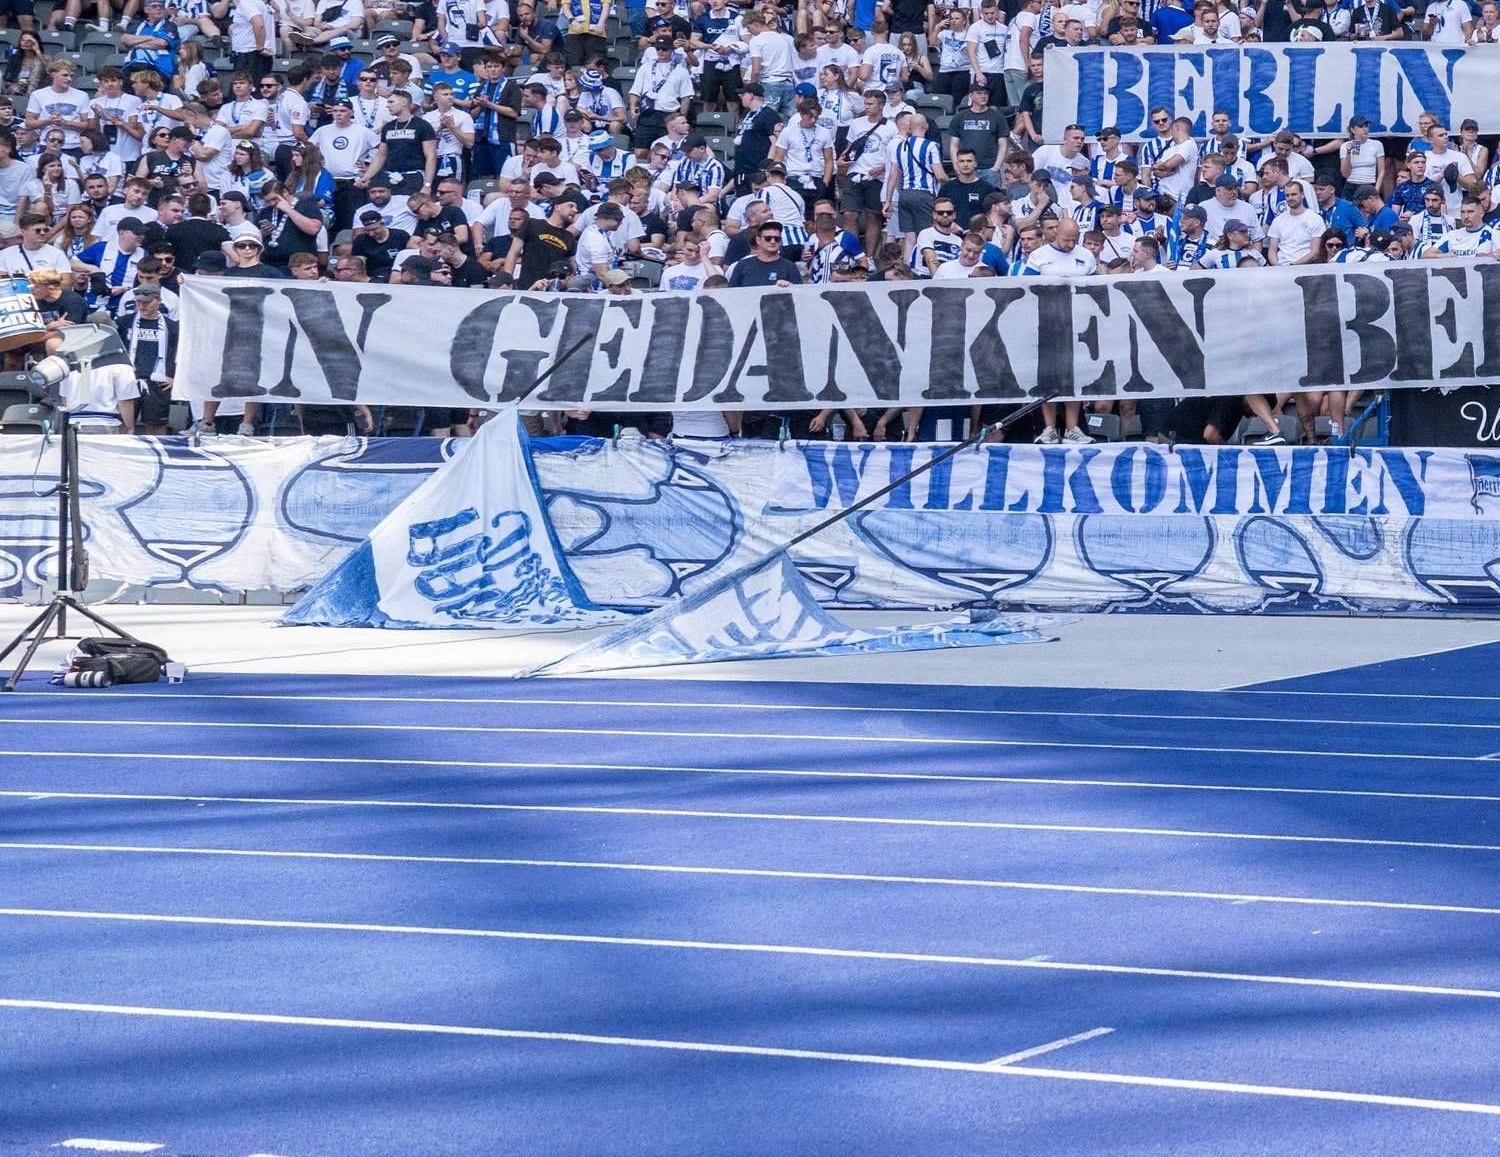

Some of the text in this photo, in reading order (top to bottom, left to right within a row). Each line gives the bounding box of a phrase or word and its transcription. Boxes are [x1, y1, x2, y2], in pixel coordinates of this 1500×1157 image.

[1072, 45, 1463, 141] BERLIN
[209, 285, 391, 401] IN
[450, 275, 1216, 404] GEDANKEN
[803, 443, 1432, 515] WILLKOMMEN
